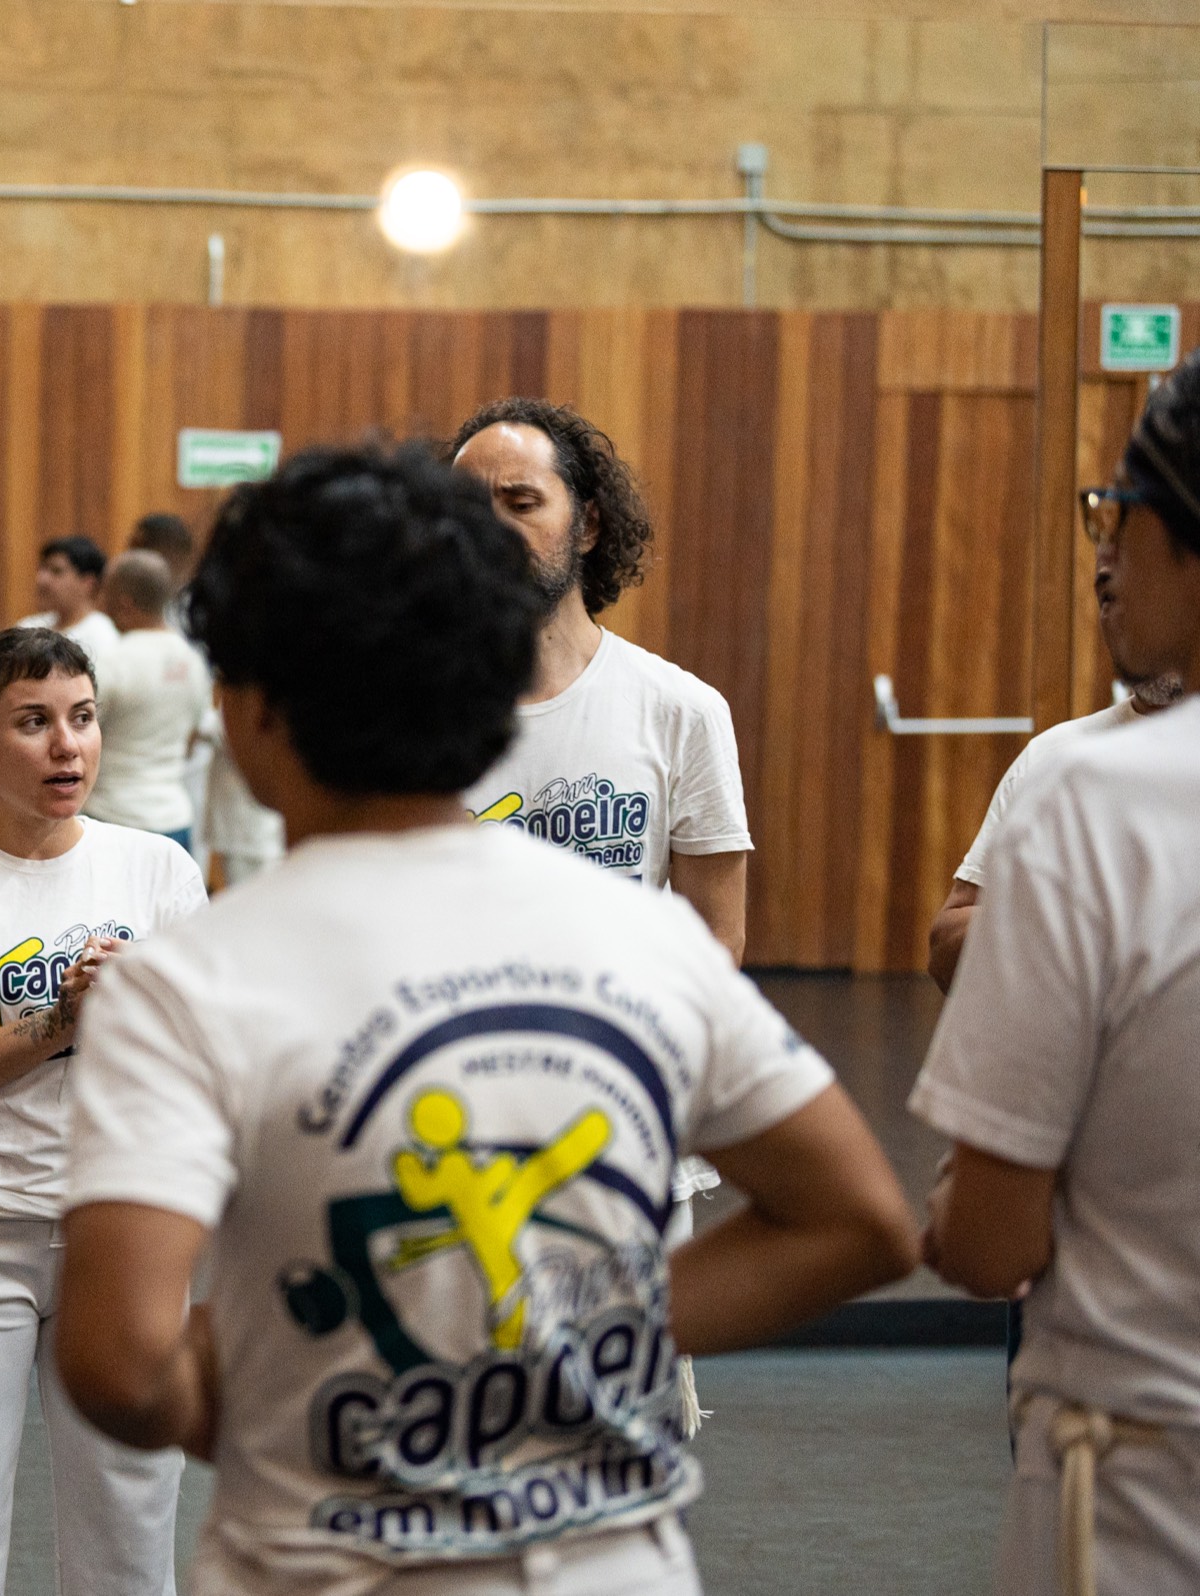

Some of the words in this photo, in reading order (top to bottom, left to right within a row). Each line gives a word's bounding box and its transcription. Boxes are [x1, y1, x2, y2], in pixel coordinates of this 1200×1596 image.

[533, 772, 597, 812] Pura
[483, 781, 647, 846] poeira
[328, 1500, 436, 1542] em
